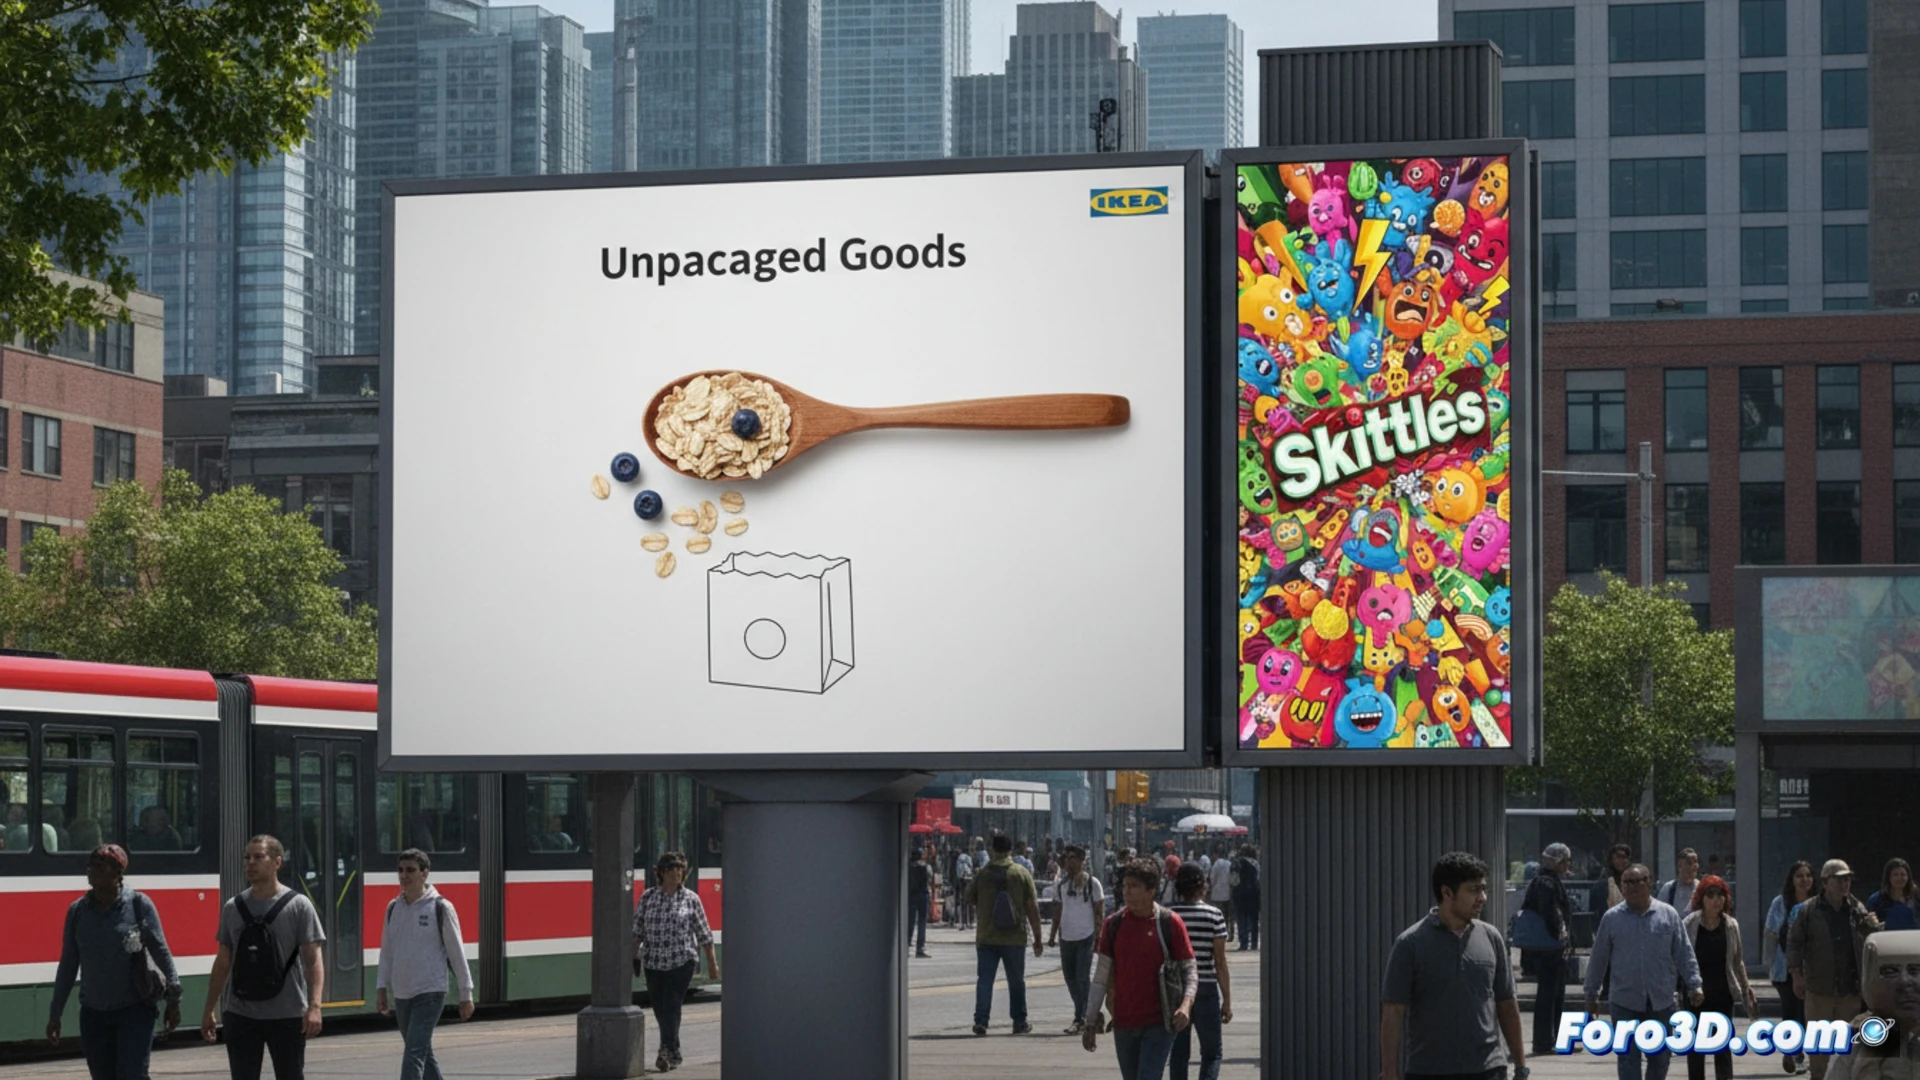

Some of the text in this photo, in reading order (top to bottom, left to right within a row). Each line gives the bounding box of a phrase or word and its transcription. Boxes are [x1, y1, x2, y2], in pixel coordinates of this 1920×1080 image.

[1097, 194, 1163, 208] IKEA
[601, 233, 967, 286] Unpacaged Goods
[1274, 391, 1486, 498] Skittles
